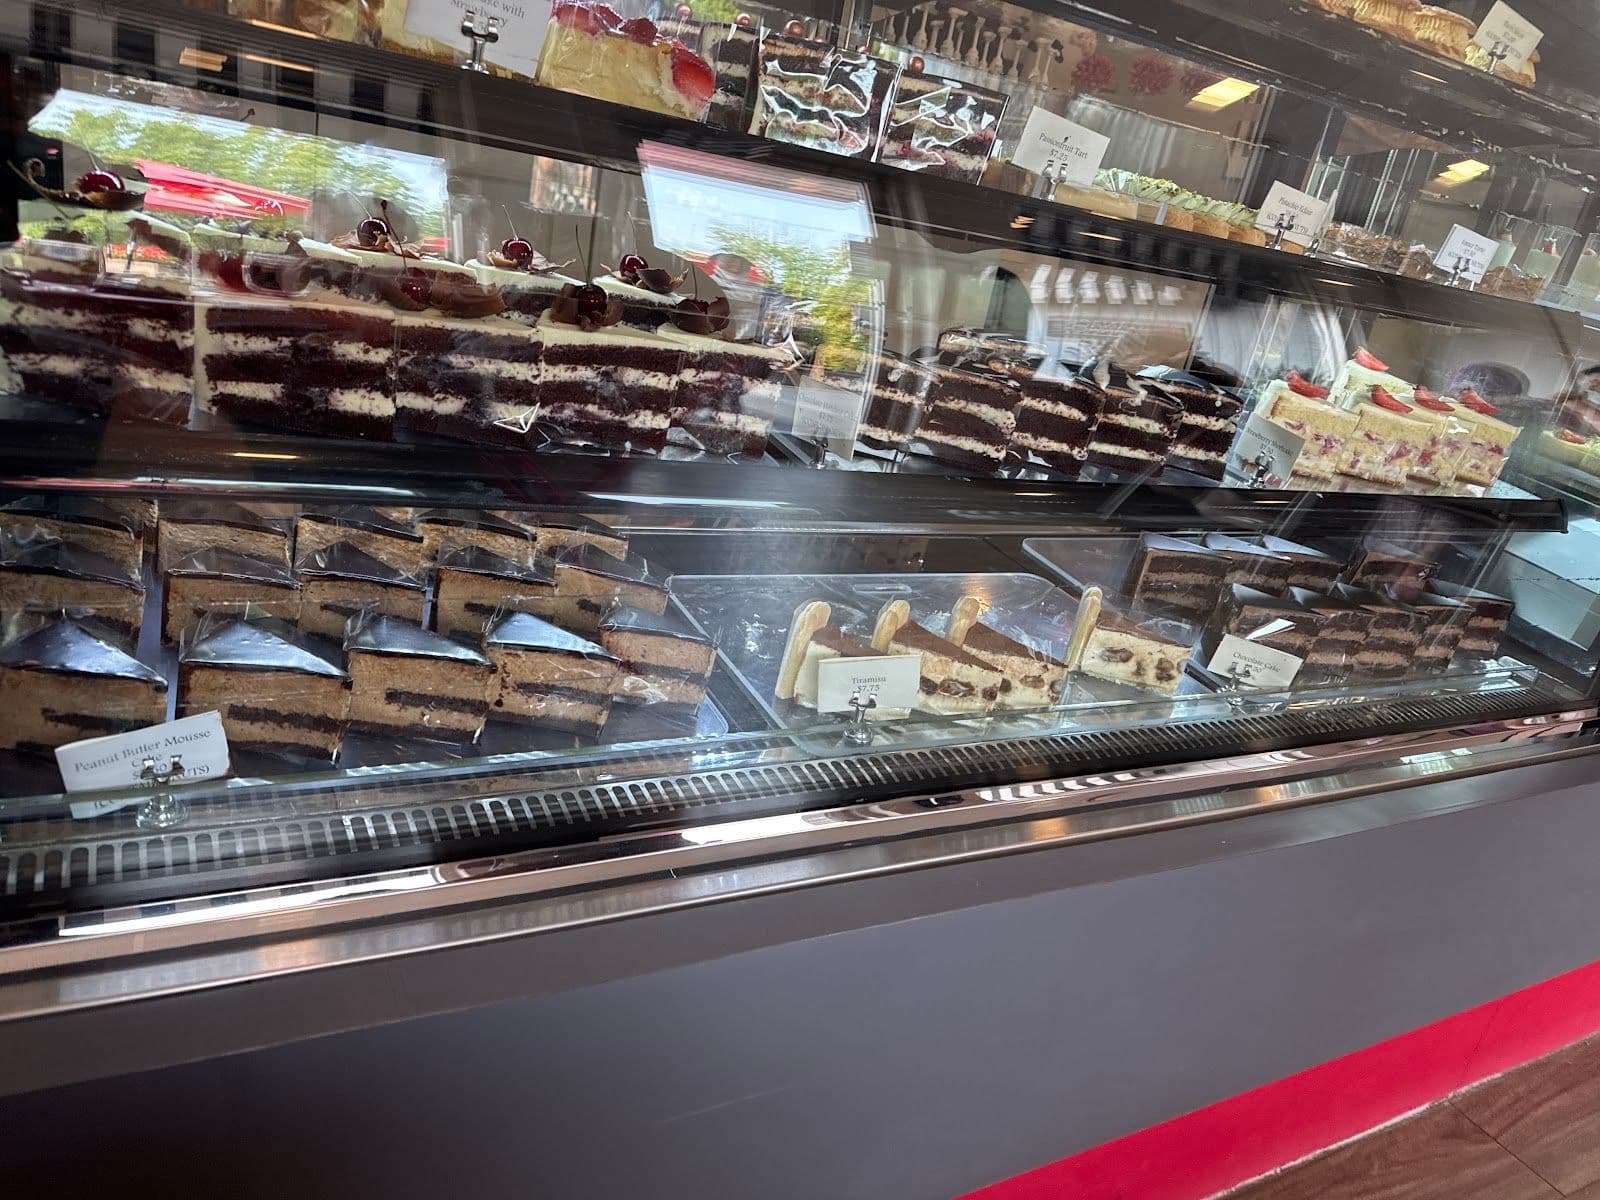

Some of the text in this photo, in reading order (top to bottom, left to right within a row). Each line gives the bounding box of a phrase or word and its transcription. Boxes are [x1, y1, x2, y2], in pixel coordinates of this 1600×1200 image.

[503, 2, 526, 19] with
[1074, 146, 1088, 159] Tart
[1233, 651, 1264, 668] Chocolate
[851, 675, 887, 685] Tiramisu
[74, 730, 212, 772] Peanut Butter Mousse
[131, 753, 163, 768] Cke
